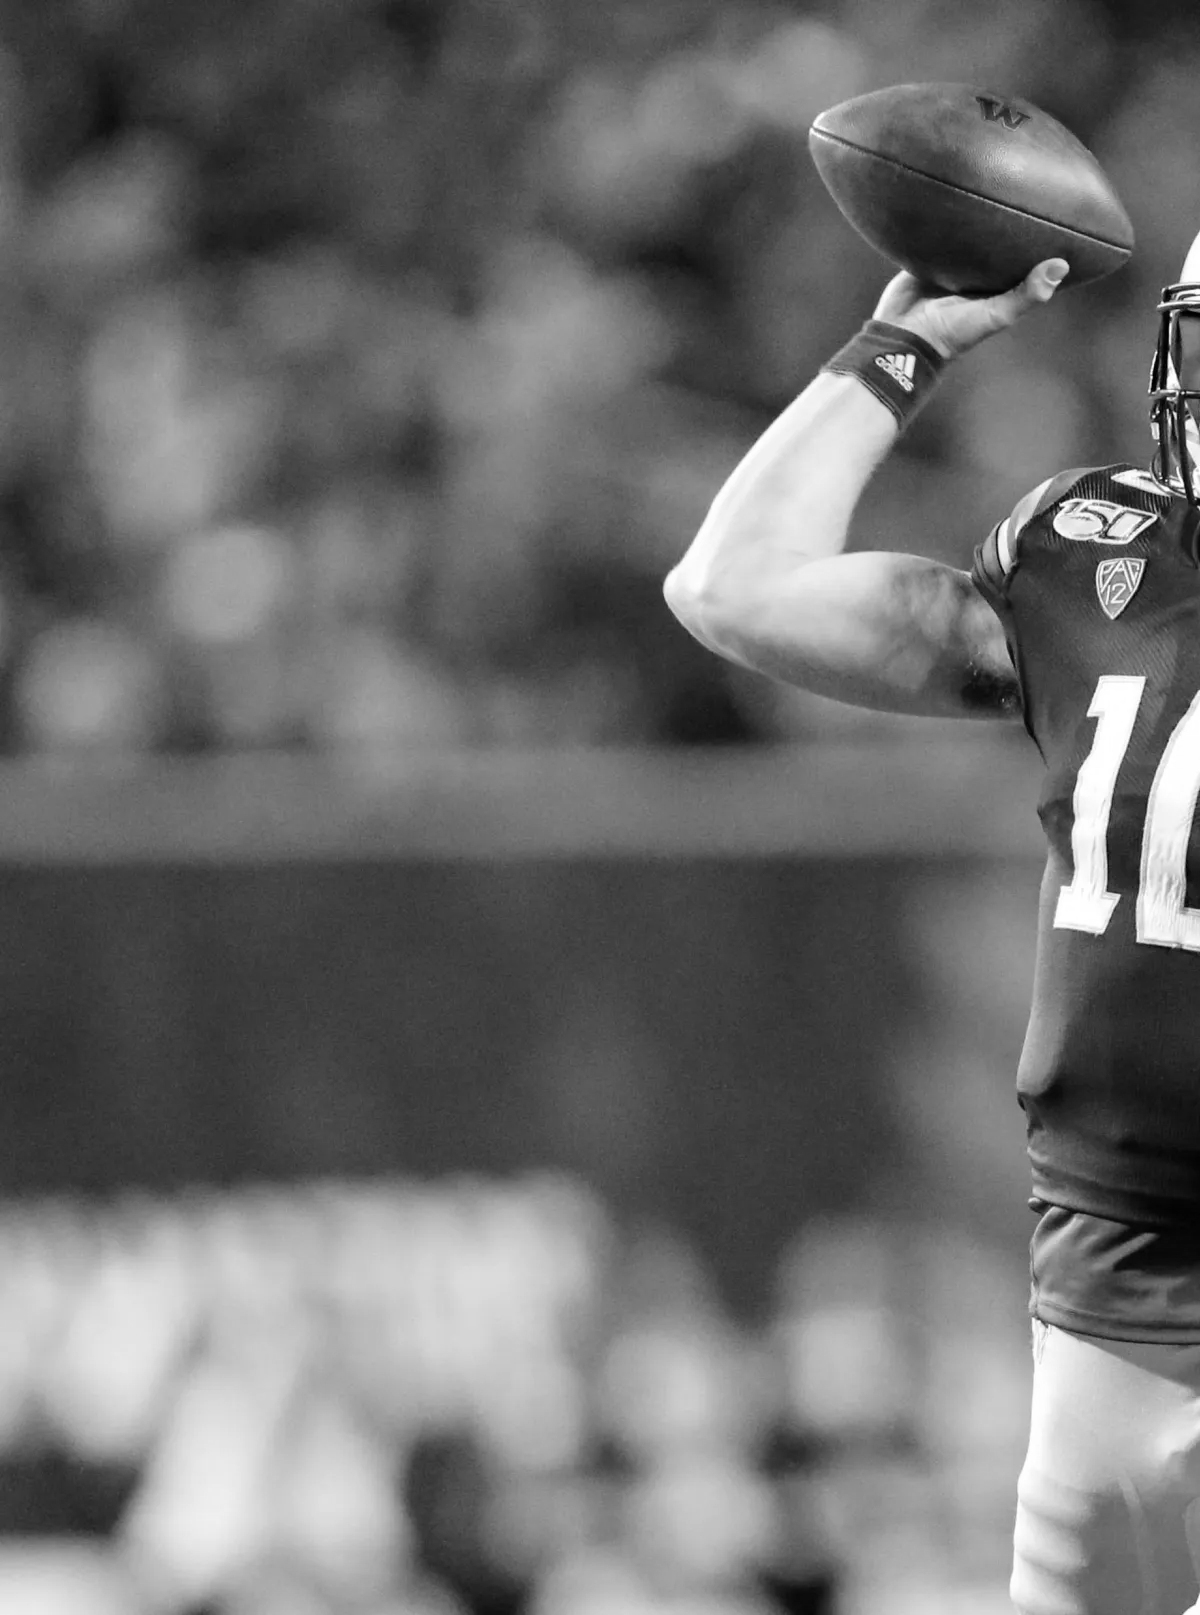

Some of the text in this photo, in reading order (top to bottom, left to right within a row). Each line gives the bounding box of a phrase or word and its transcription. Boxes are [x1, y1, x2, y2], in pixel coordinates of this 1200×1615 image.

[976, 96, 1031, 131] W
[875, 356, 914, 392] adidas
[1105, 583, 1127, 605] 12
